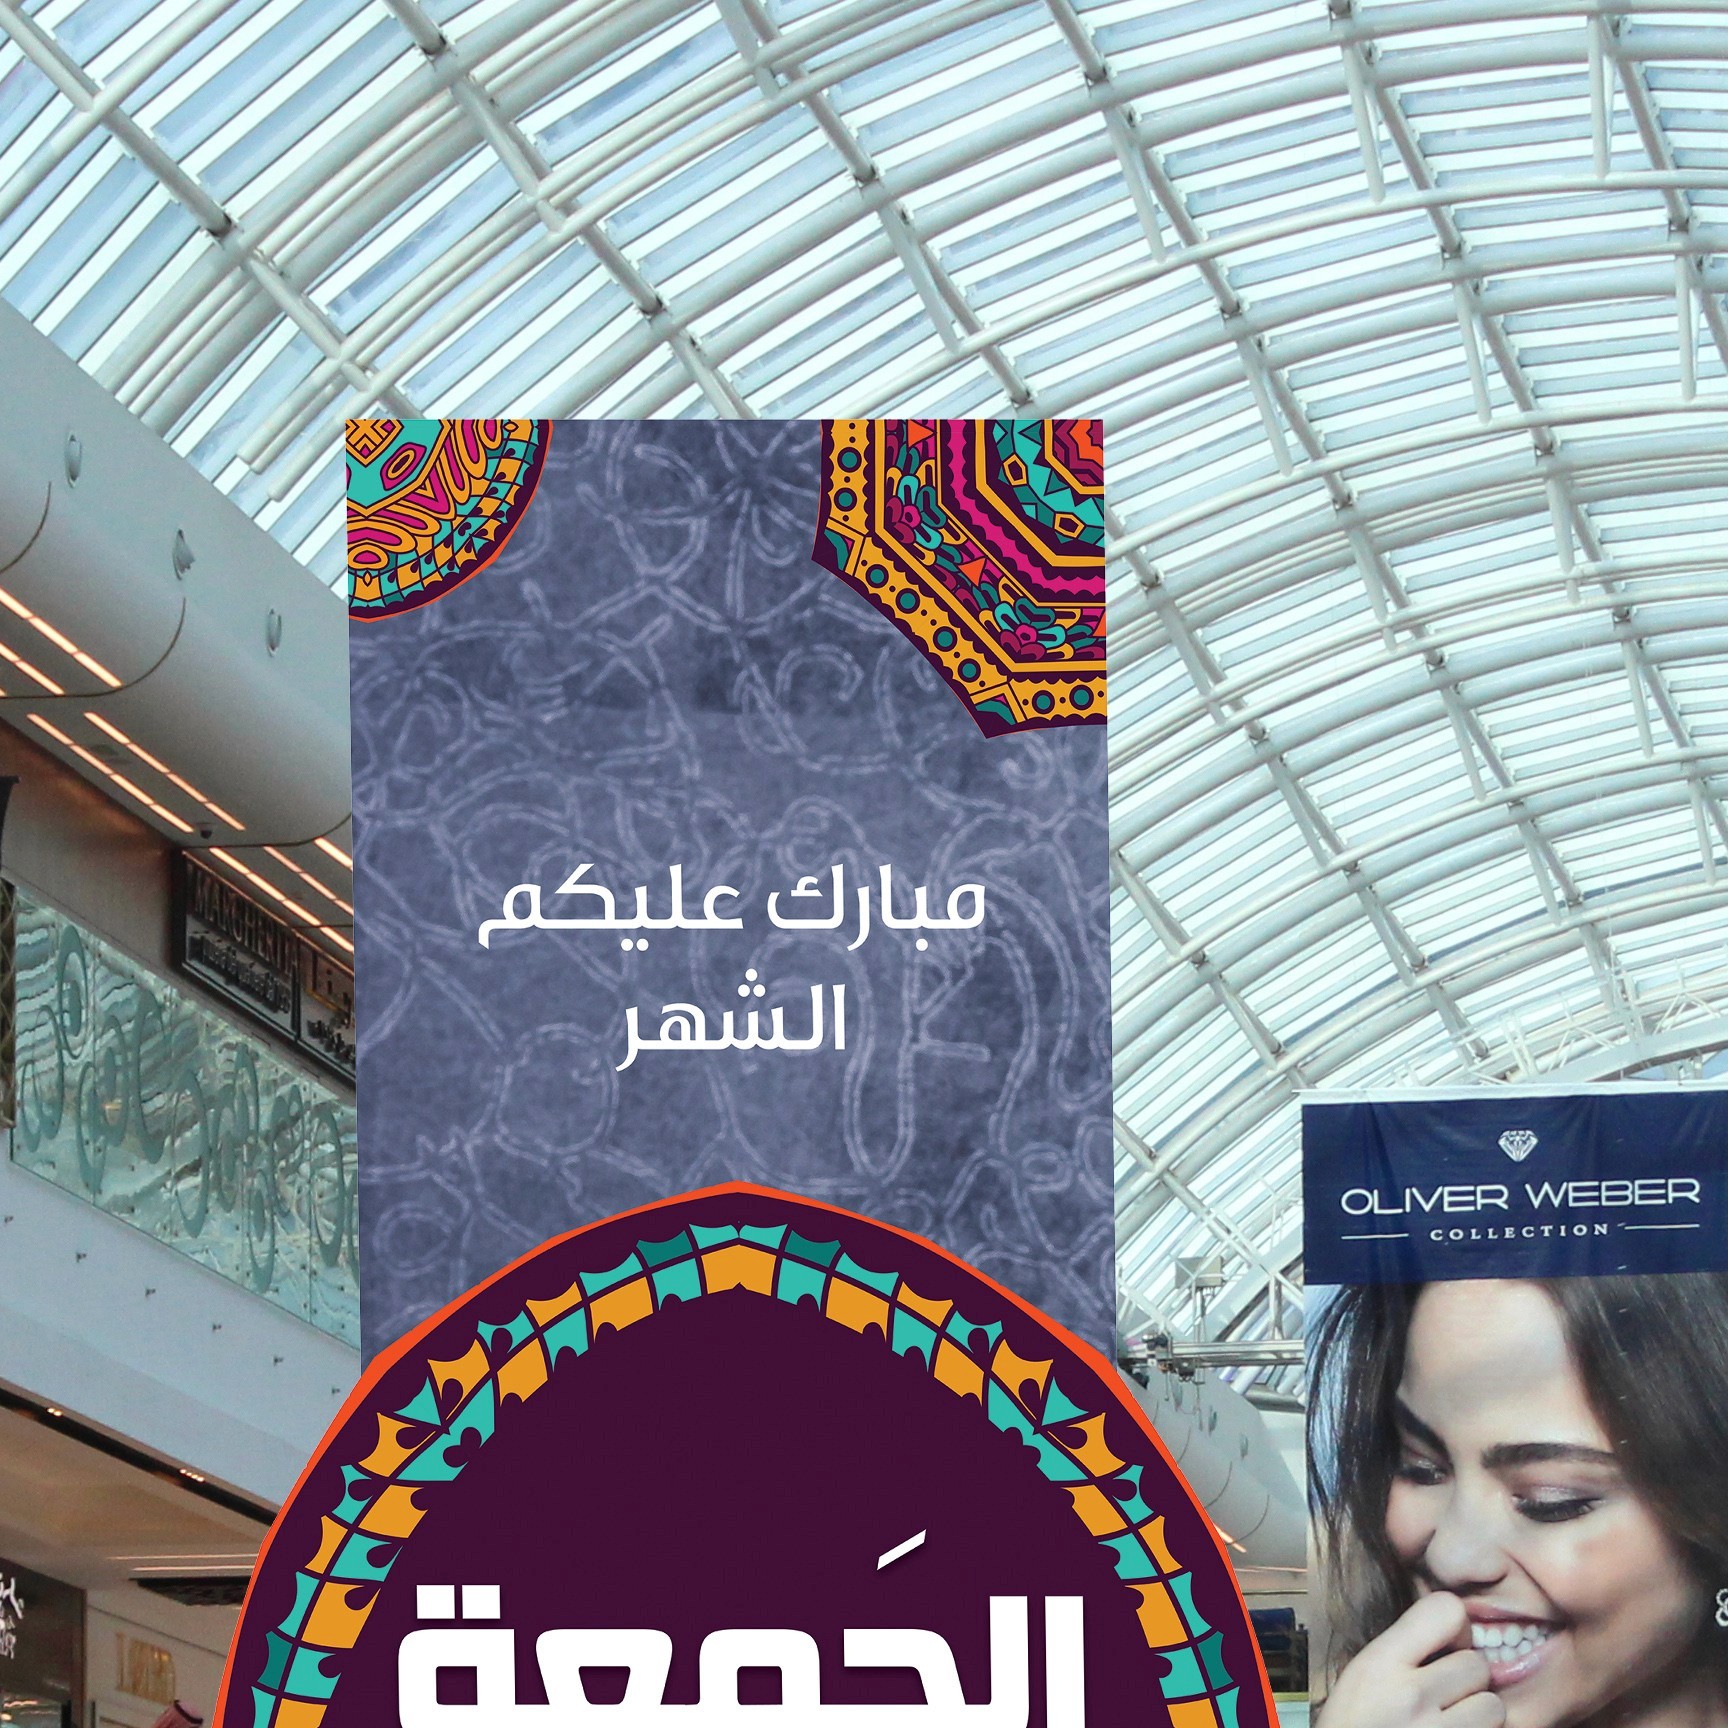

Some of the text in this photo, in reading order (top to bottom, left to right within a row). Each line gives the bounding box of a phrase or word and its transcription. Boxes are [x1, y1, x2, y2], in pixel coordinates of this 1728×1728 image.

[478, 863, 986, 952] مبارك عليكم
[615, 968, 846, 1072] الشهر
[1341, 1177, 1701, 1215] OLIVER WEBER
[1430, 1222, 1609, 1241] COLLECTION
